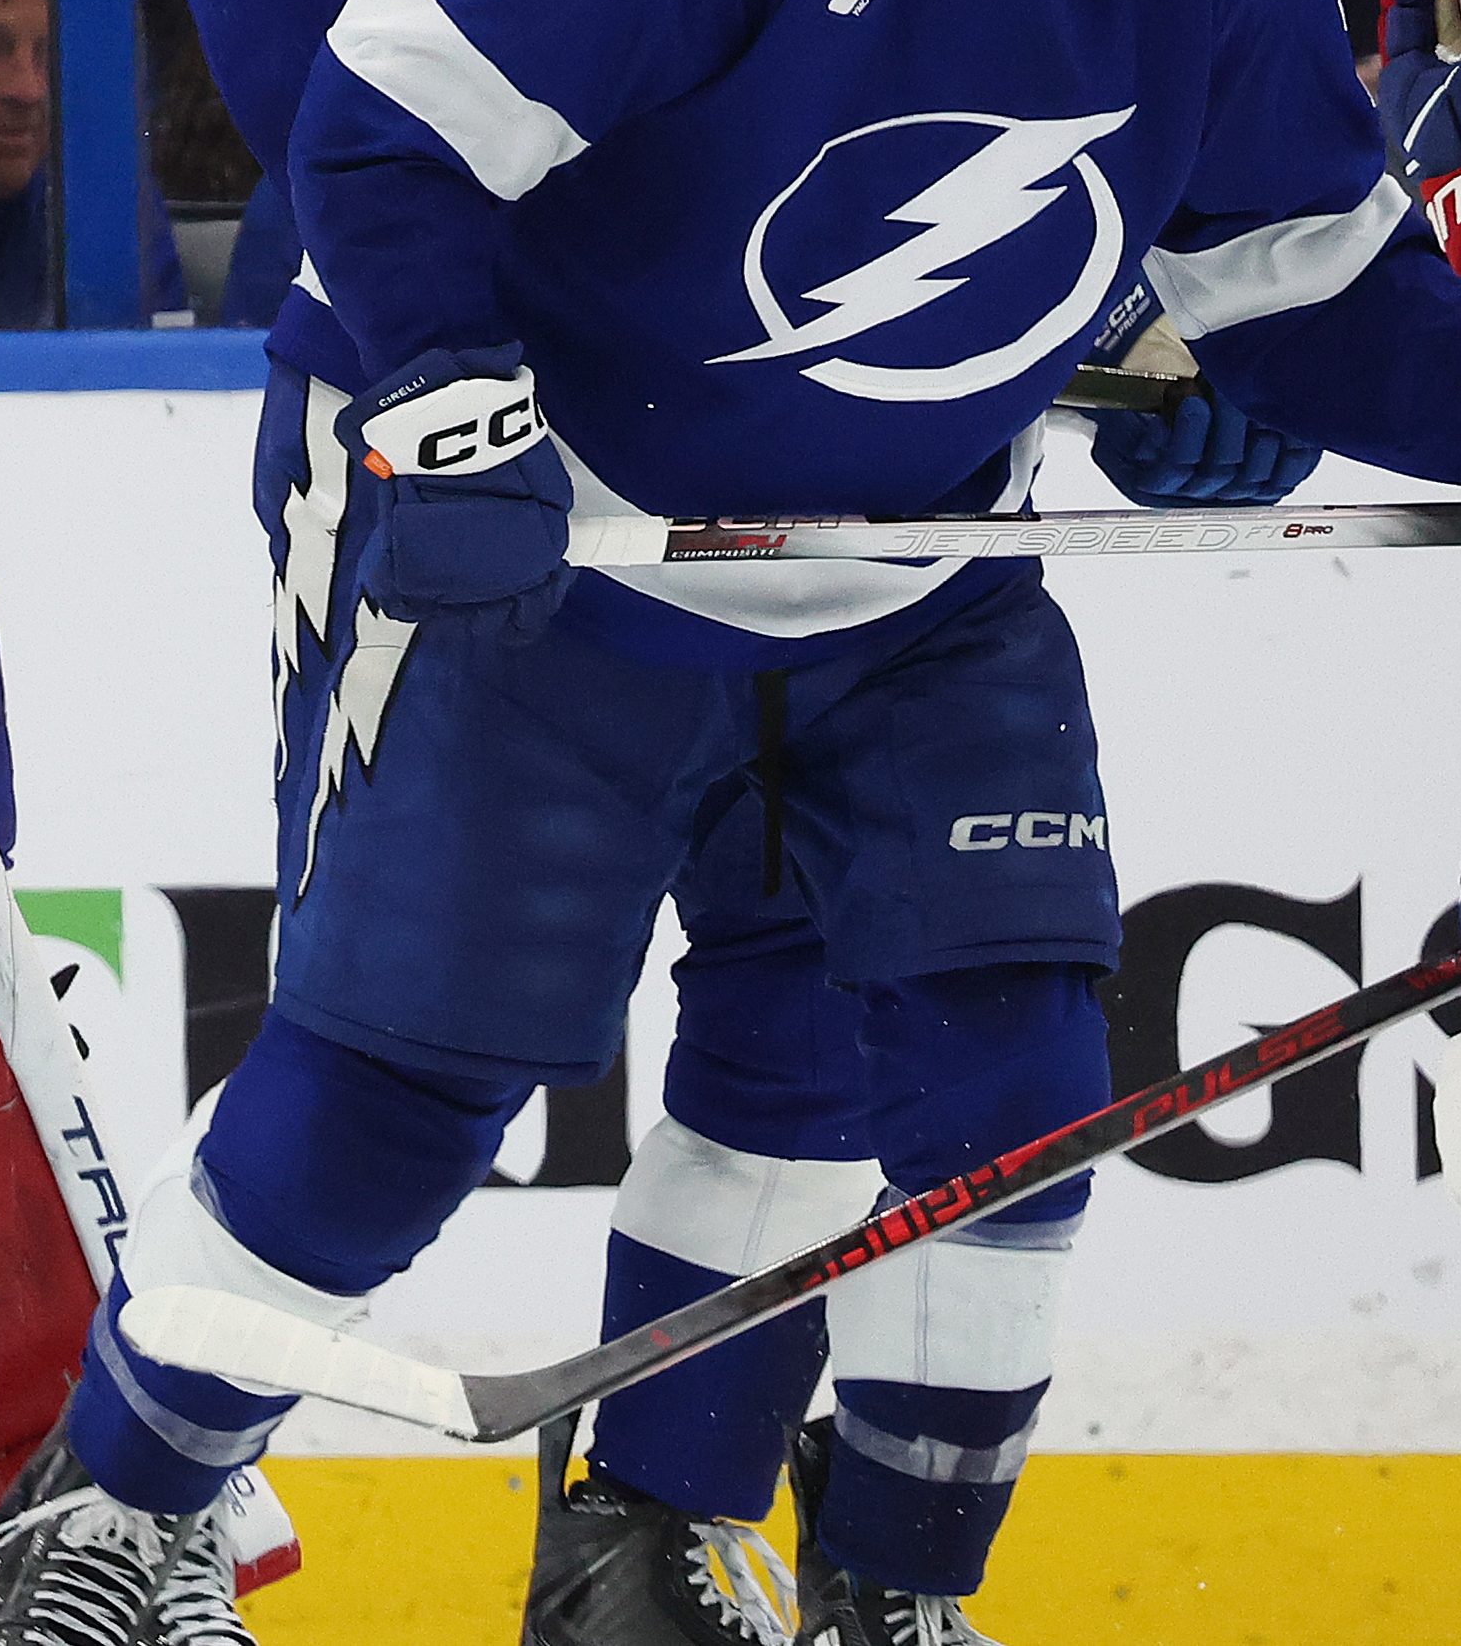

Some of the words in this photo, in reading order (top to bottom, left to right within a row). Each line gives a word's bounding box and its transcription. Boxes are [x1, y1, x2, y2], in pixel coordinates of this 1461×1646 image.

[378, 375, 427, 408] CIRELLI
[880, 522, 1239, 557] JETSPEED
[947, 810, 1107, 852] CCM
[1130, 1001, 1347, 1139] PULSE
